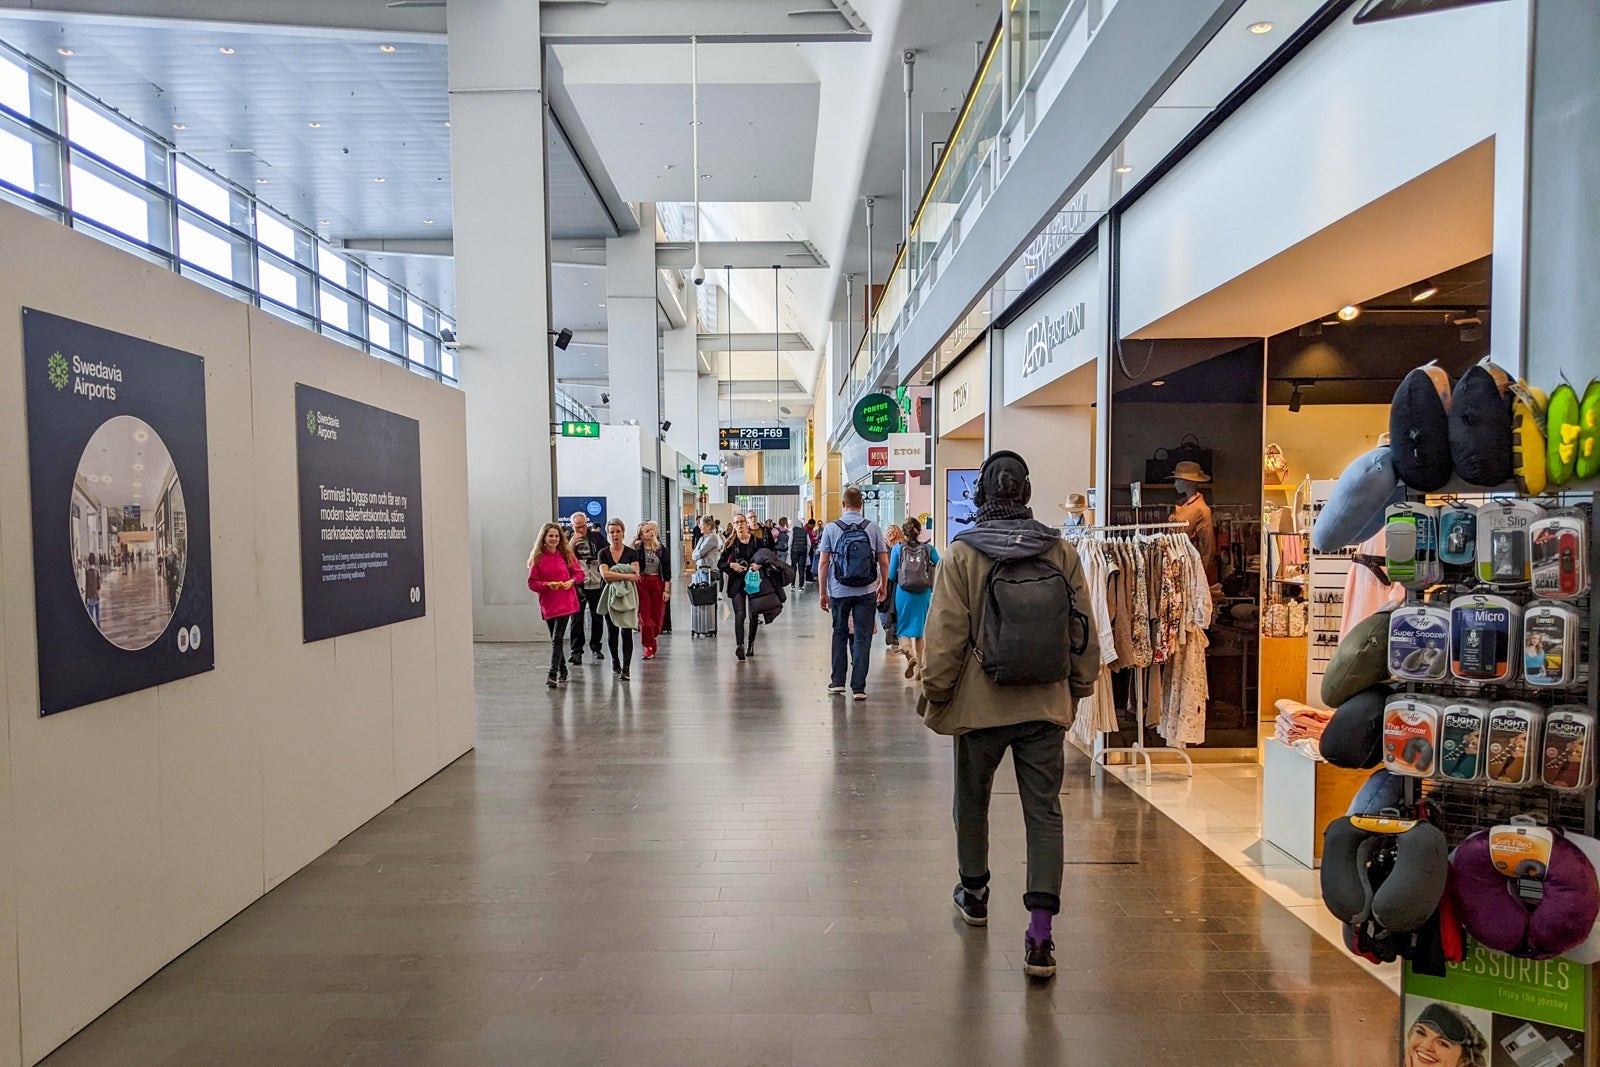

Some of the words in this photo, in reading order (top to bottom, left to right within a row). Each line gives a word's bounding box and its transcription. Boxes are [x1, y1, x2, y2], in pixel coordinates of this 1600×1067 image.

[1048, 302, 1084, 350] FASHION
[72, 355, 123, 383] Swedavia
[74, 377, 116, 401] Airports
[953, 382, 969, 412] ETON
[863, 402, 888, 414] PONTUS
[317, 411, 340, 428] Swedavia
[876, 414, 888, 424] THE
[318, 425, 337, 440] Airports
[740, 428, 783, 438] F26-F69
[893, 448, 921, 456] ETON
[320, 484, 346, 502] Terminal
[346, 487, 351, 502] 5
[351, 488, 368, 507] byggs
[369, 493, 377, 504] om
[378, 492, 388, 505] och
[320, 506, 344, 521] modern
[1507, 516, 1527, 528] Slip
[321, 525, 364, 543] marknadsplats
[365, 526, 375, 540] och
[1417, 518, 1428, 544] bright
[1535, 579, 1558, 589] SCALE
[1455, 610, 1475, 621] The
[1475, 611, 1504, 622] Micro
[1393, 629, 1415, 638] Super
[1416, 630, 1447, 639] Snoozer
[1445, 721, 1479, 731] SOCKS
[1446, 715, 1480, 725] FLIGHT
[1492, 718, 1527, 728] FLIGHT
[1387, 723, 1401, 731] The
[1401, 724, 1427, 735] Snoozer
[1491, 723, 1526, 732] SOCKS
[1550, 722, 1584, 732] FLIGHT
[1495, 837, 1512, 846] Soft
[1512, 839, 1532, 849] Filled
[1448, 948, 1569, 990] ESSORIES
[1498, 987, 1519, 1000] Enjoy
[1522, 991, 1535, 1003] the
[1537, 996, 1569, 1011] journey
